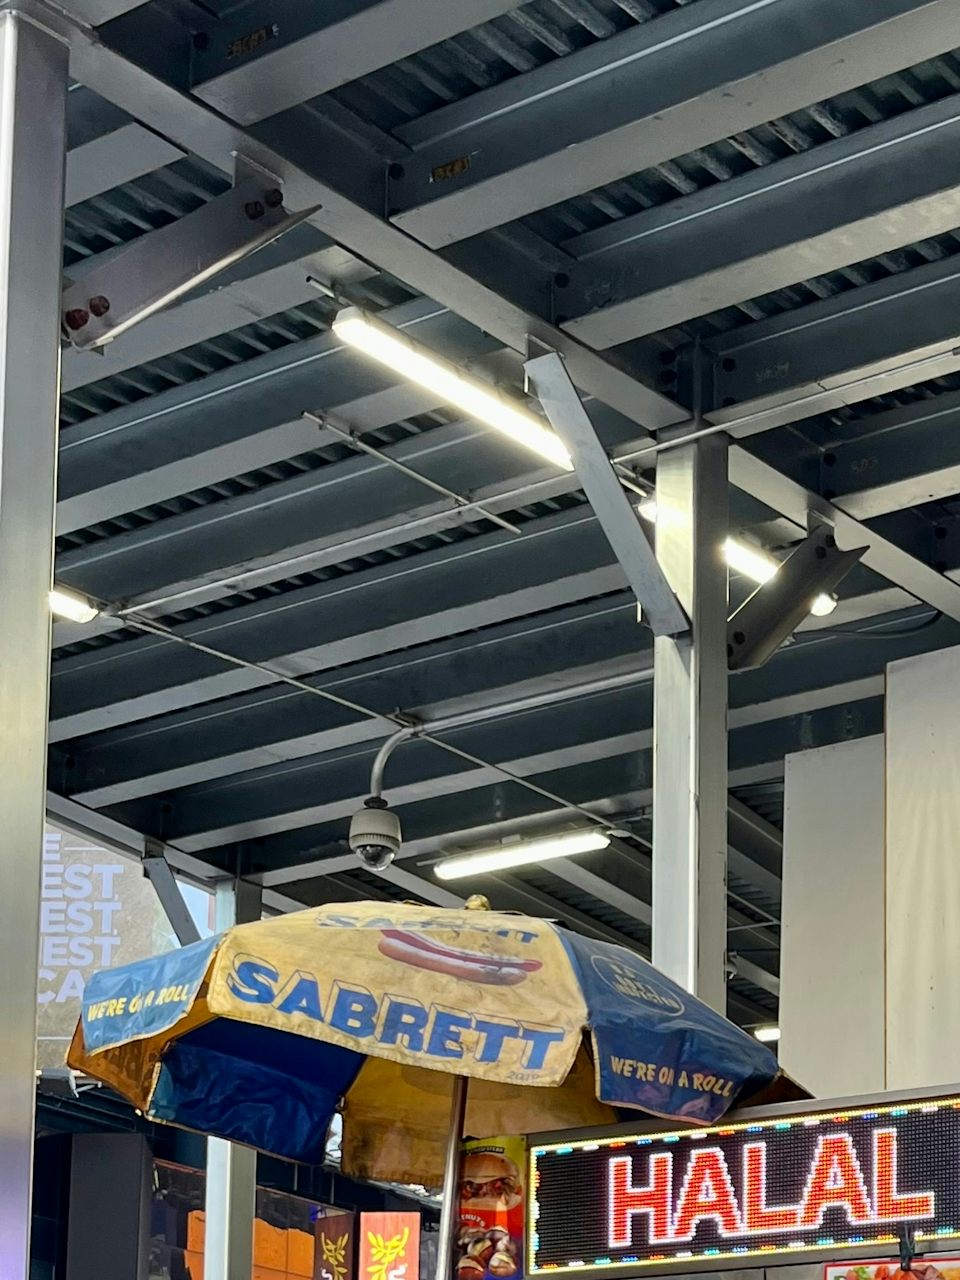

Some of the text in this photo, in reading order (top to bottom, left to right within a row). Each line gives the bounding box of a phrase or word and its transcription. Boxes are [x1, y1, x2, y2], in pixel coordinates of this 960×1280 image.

[88, 996, 128, 1022] WE'RE
[155, 984, 190, 1006] ROLL
[226, 952, 566, 1071] SABRETT
[610, 1055, 657, 1082] WE'RE
[678, 1071, 690, 1089] A
[692, 1073, 733, 1097] ROLL
[608, 1127, 935, 1250] HALAL
